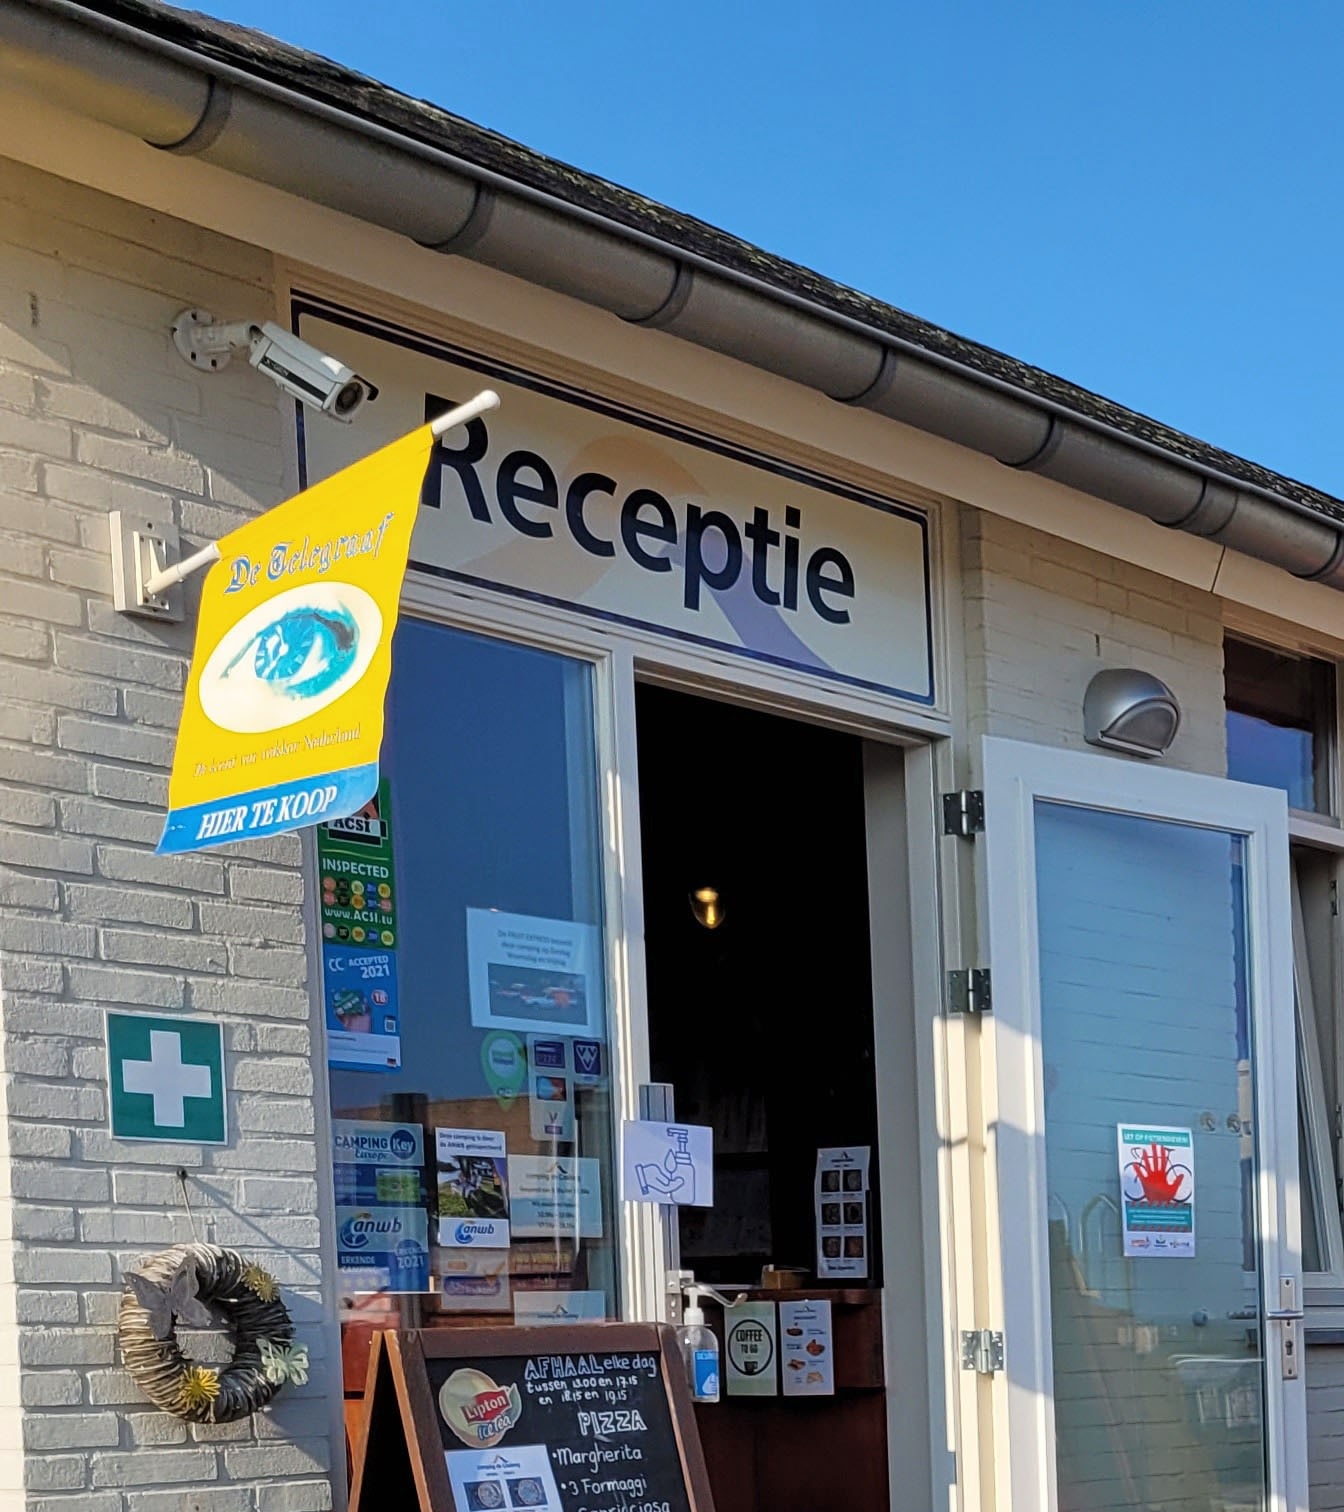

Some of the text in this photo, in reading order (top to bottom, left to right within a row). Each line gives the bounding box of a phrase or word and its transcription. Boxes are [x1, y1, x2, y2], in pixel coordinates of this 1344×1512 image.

[423, 393, 856, 626] Receptie
[224, 512, 394, 593] De Telegraaf
[195, 785, 338, 841] HIER TE KOOP
[334, 818, 371, 833] ACSI
[322, 857, 389, 878] INSPECTED
[329, 955, 389, 972] CC ACCEPTED
[362, 964, 391, 979] 2021
[334, 1135, 414, 1151] CAMPING Key
[353, 1216, 402, 1233] anwb
[463, 1223, 495, 1235] anwb
[341, 1255, 424, 1268] ERKENDE 2021
[735, 1329, 763, 1342] COFFEE
[741, 1343, 749, 1353] TO
[524, 1354, 657, 1380] AFHAAL elke dag
[526, 1378, 568, 1394] tussen
[599, 1376, 613, 1387] en
[539, 1397, 553, 1405] en
[584, 1390, 599, 1400] en
[465, 1395, 507, 1419] Lipton
[577, 1409, 648, 1436] PIZZA
[557, 1442, 643, 1473] Margherita
[568, 1474, 648, 1498] 3 Formaggi
